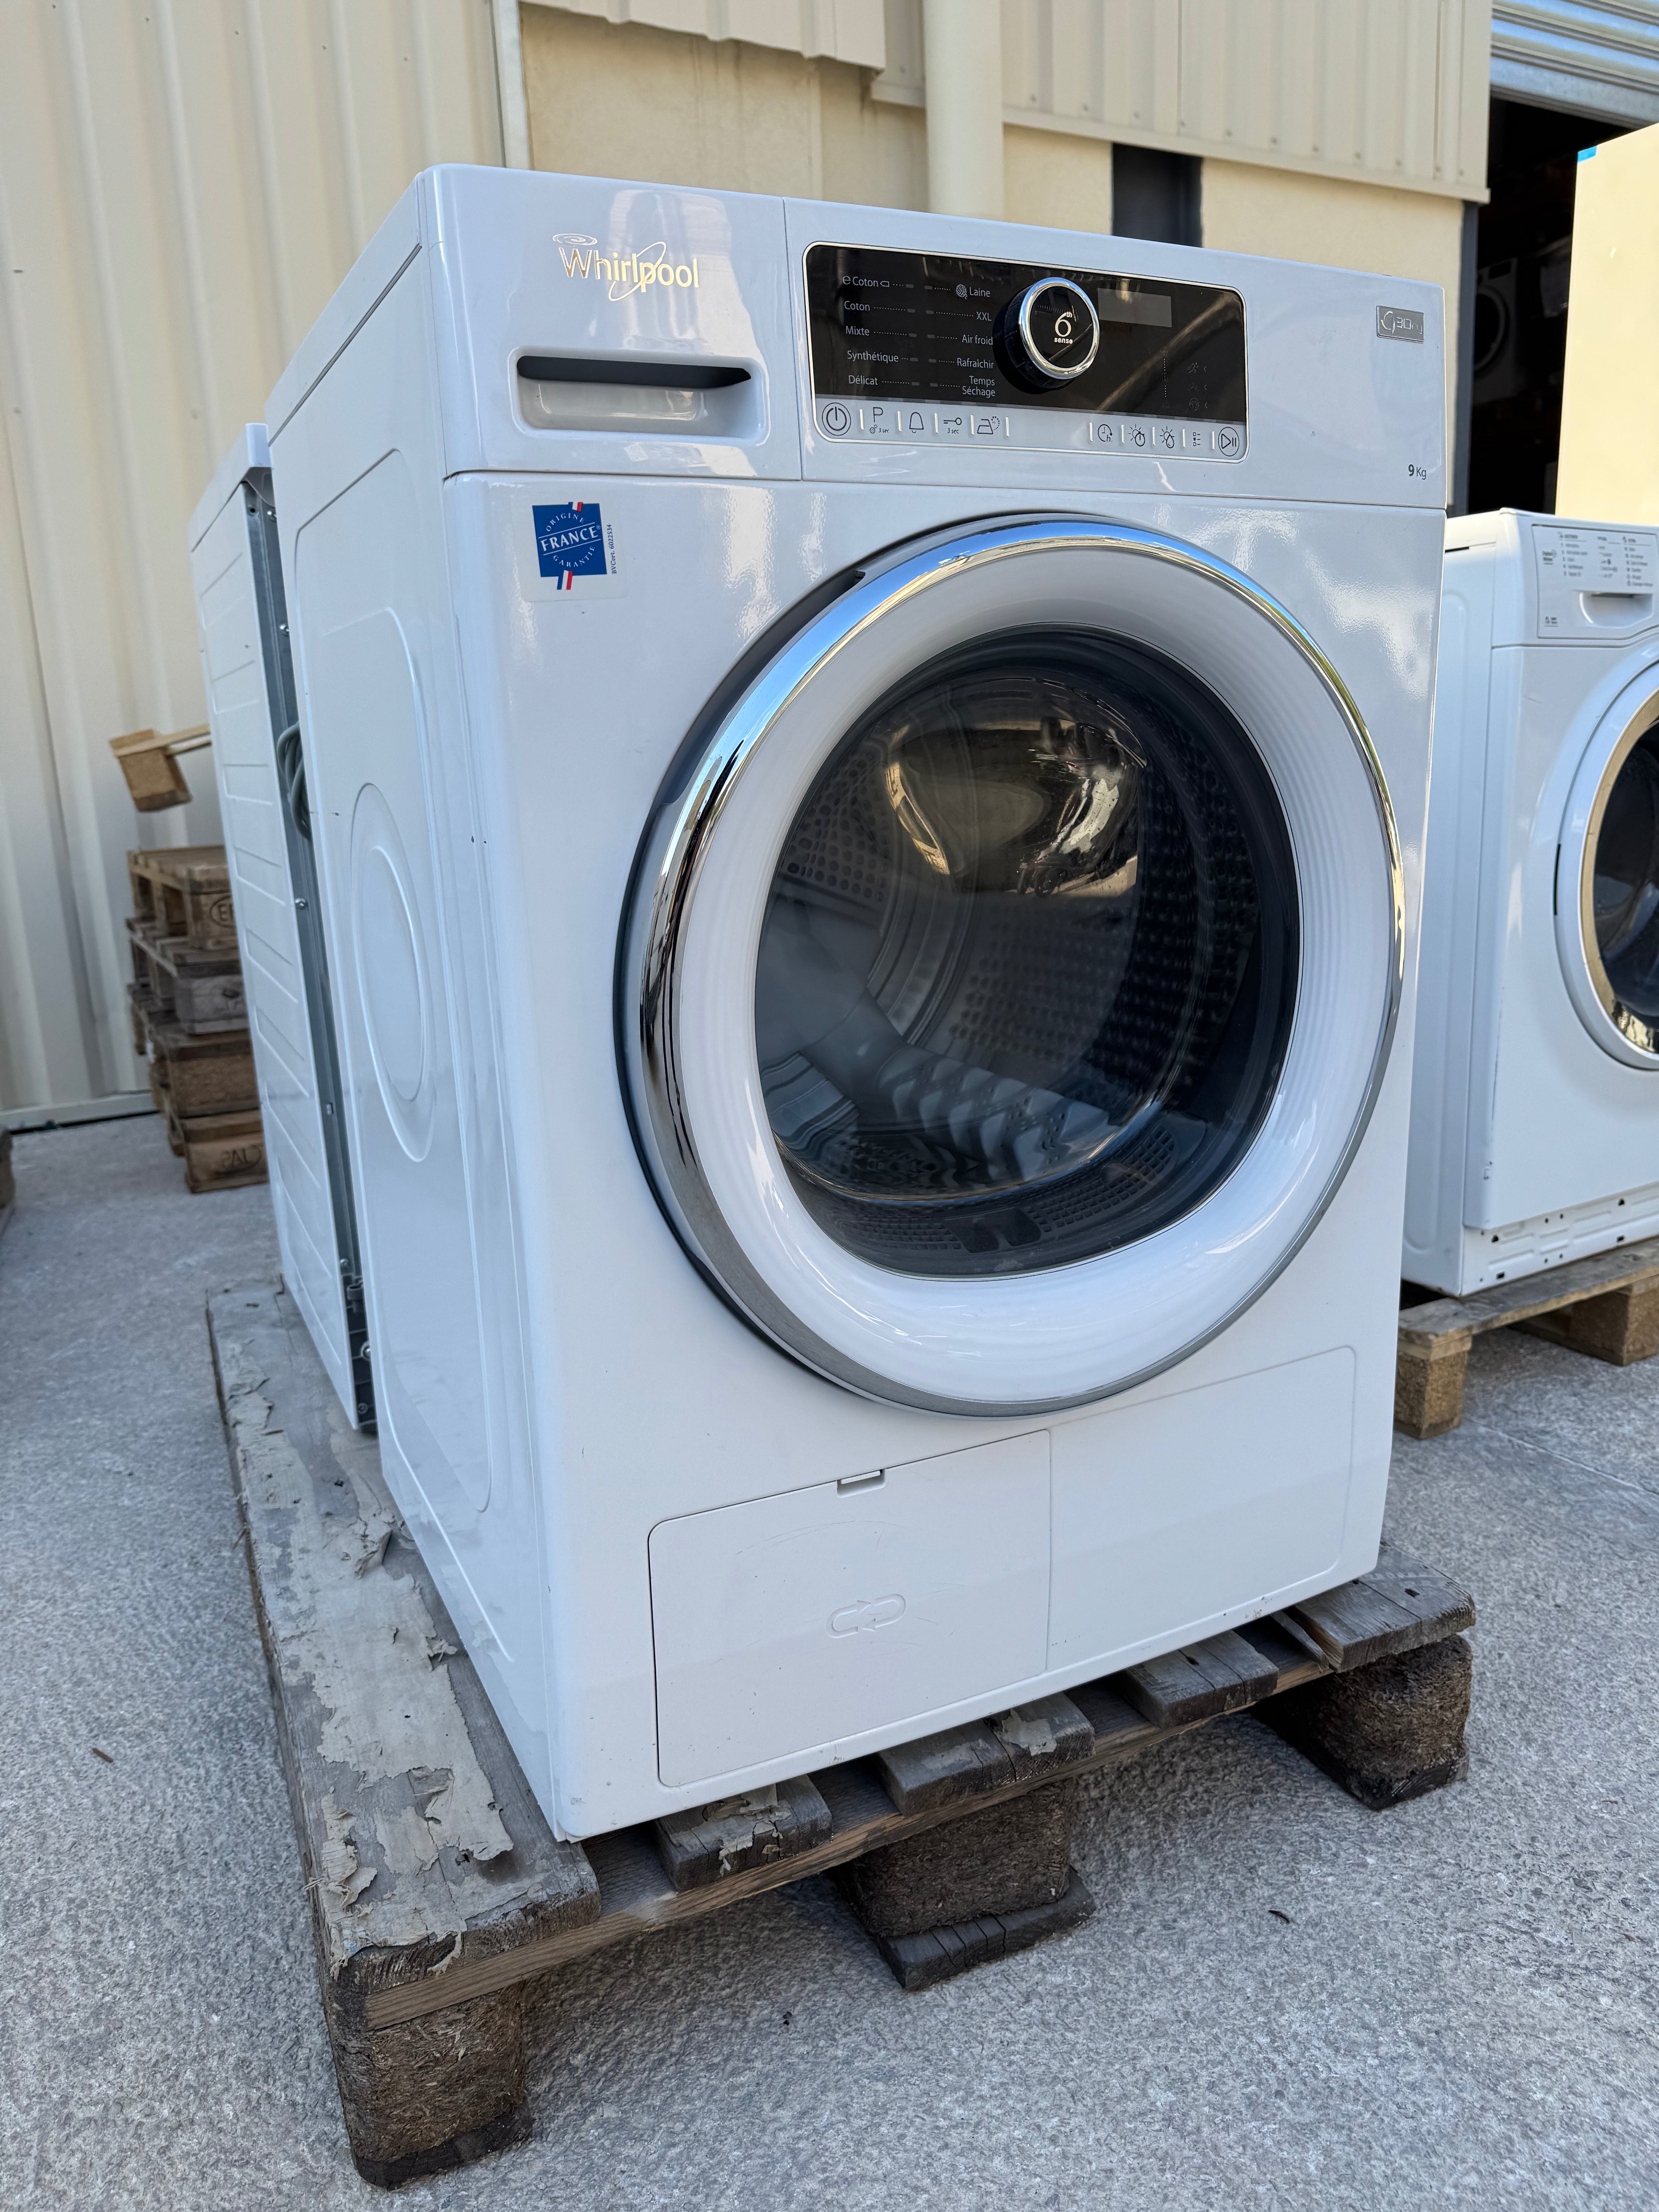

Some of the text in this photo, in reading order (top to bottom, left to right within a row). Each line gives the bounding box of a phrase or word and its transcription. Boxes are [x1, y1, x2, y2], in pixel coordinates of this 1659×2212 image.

[558, 247, 699, 292] Whirlpool
[852, 276, 879, 287] Coton
[969, 287, 991, 297] Laine
[844, 301, 870, 311] Coton
[976, 312, 992, 321] XXL
[846, 326, 870, 336] Mixte
[962, 334, 993, 345] Air froid
[847, 350, 899, 363] Synthétique
[848, 375, 878, 385] Délicat
[969, 376, 995, 387] Temps
[962, 386, 996, 398] Séchage
[1408, 464, 1427, 480] 9 Kg
[546, 513, 585, 532] ORIGINE
[541, 526, 599, 551] FRANCE
[553, 546, 595, 567] GARANTIE
